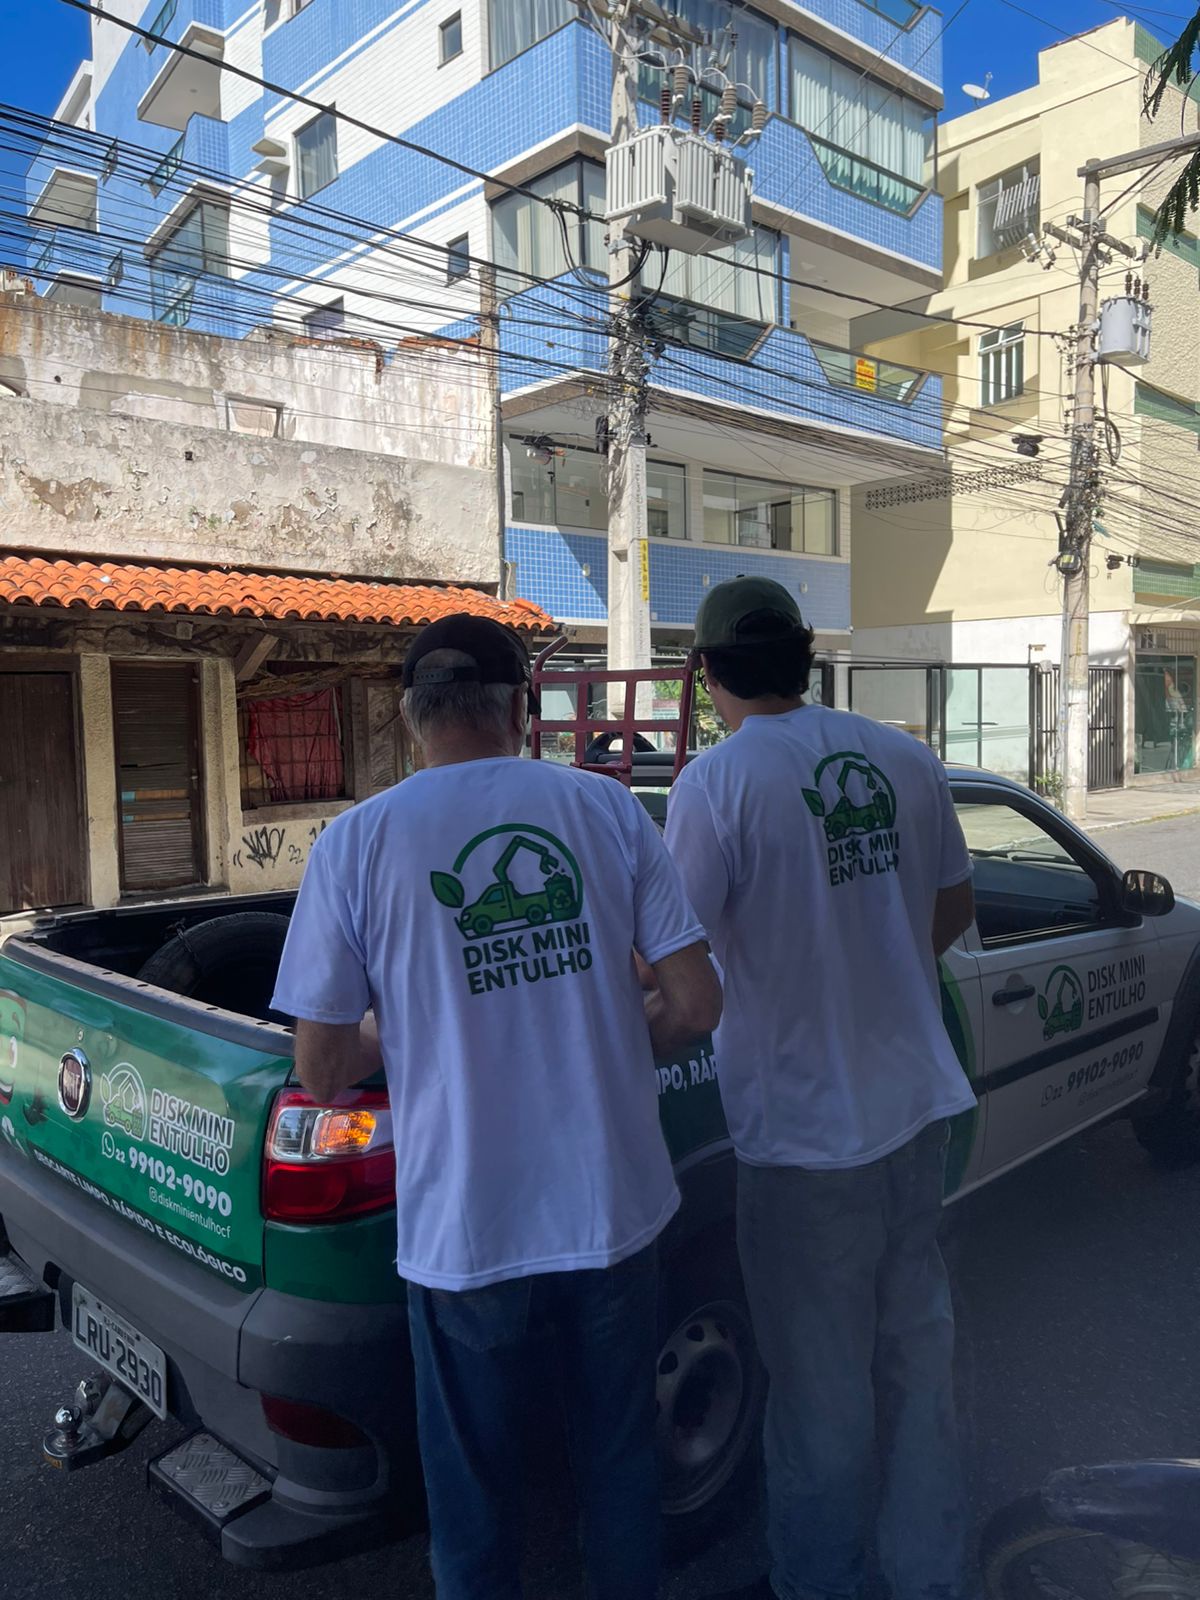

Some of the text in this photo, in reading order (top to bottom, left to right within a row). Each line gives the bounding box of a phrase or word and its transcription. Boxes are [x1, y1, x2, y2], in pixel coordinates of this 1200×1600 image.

[827, 838, 865, 866] DISK
[462, 922, 591, 969] DISK MINI
[467, 948, 593, 995] ENTULHO
[1087, 954, 1146, 993] DISK MINI
[1088, 981, 1146, 1020] ENTULHO
[1067, 1040, 1144, 1093] 99102-9090
[151, 1088, 235, 1149] DISK MINI
[150, 1116, 230, 1177] ENTULHO
[115, 1147, 232, 1217] 22 99102-9090
[112, 1200, 155, 1233] RÁPIDO
[154, 1223, 167, 1240] E
[165, 1229, 247, 1283] ECOLÓGICO
